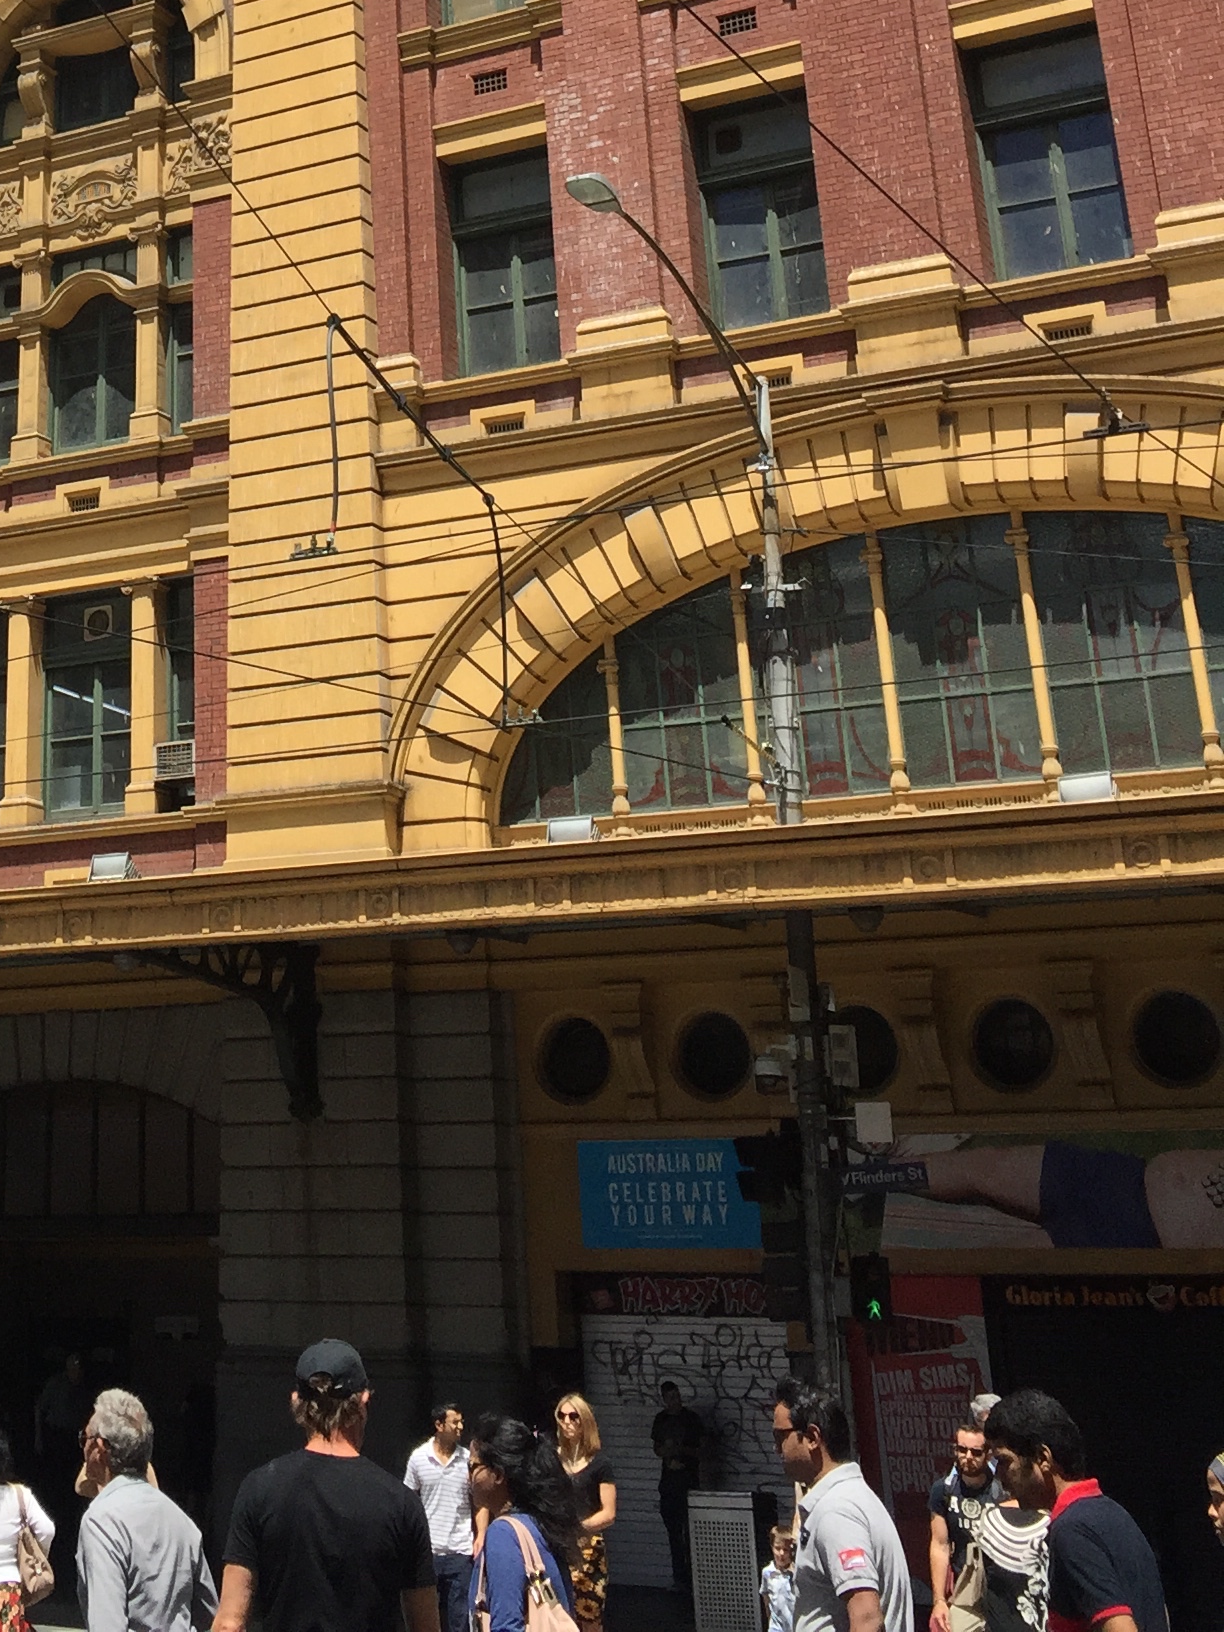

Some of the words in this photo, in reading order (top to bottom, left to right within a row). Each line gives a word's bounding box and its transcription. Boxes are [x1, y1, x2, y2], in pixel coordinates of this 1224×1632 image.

[607, 1152, 690, 1174] AUSTRALIA
[695, 1151, 725, 1173] DAY
[851, 1169, 906, 1186] Flinders
[907, 1167, 924, 1181] St
[608, 1180, 728, 1203] CELEBRATE
[610, 1204, 673, 1226] YOUR
[682, 1203, 729, 1226] WAY
[619, 1276, 719, 1314] HARRY
[1005, 1284, 1076, 1307] Gloria
[1080, 1285, 1145, 1307] Jean's
[876, 1369, 916, 1396] DIM
[919, 1362, 971, 1391] SIMS
[880, 1401, 928, 1417] SPRING
[930, 1401, 968, 1417] ROLLS
[882, 1416, 928, 1440] WON
[888, 1455, 936, 1474] POTATO
